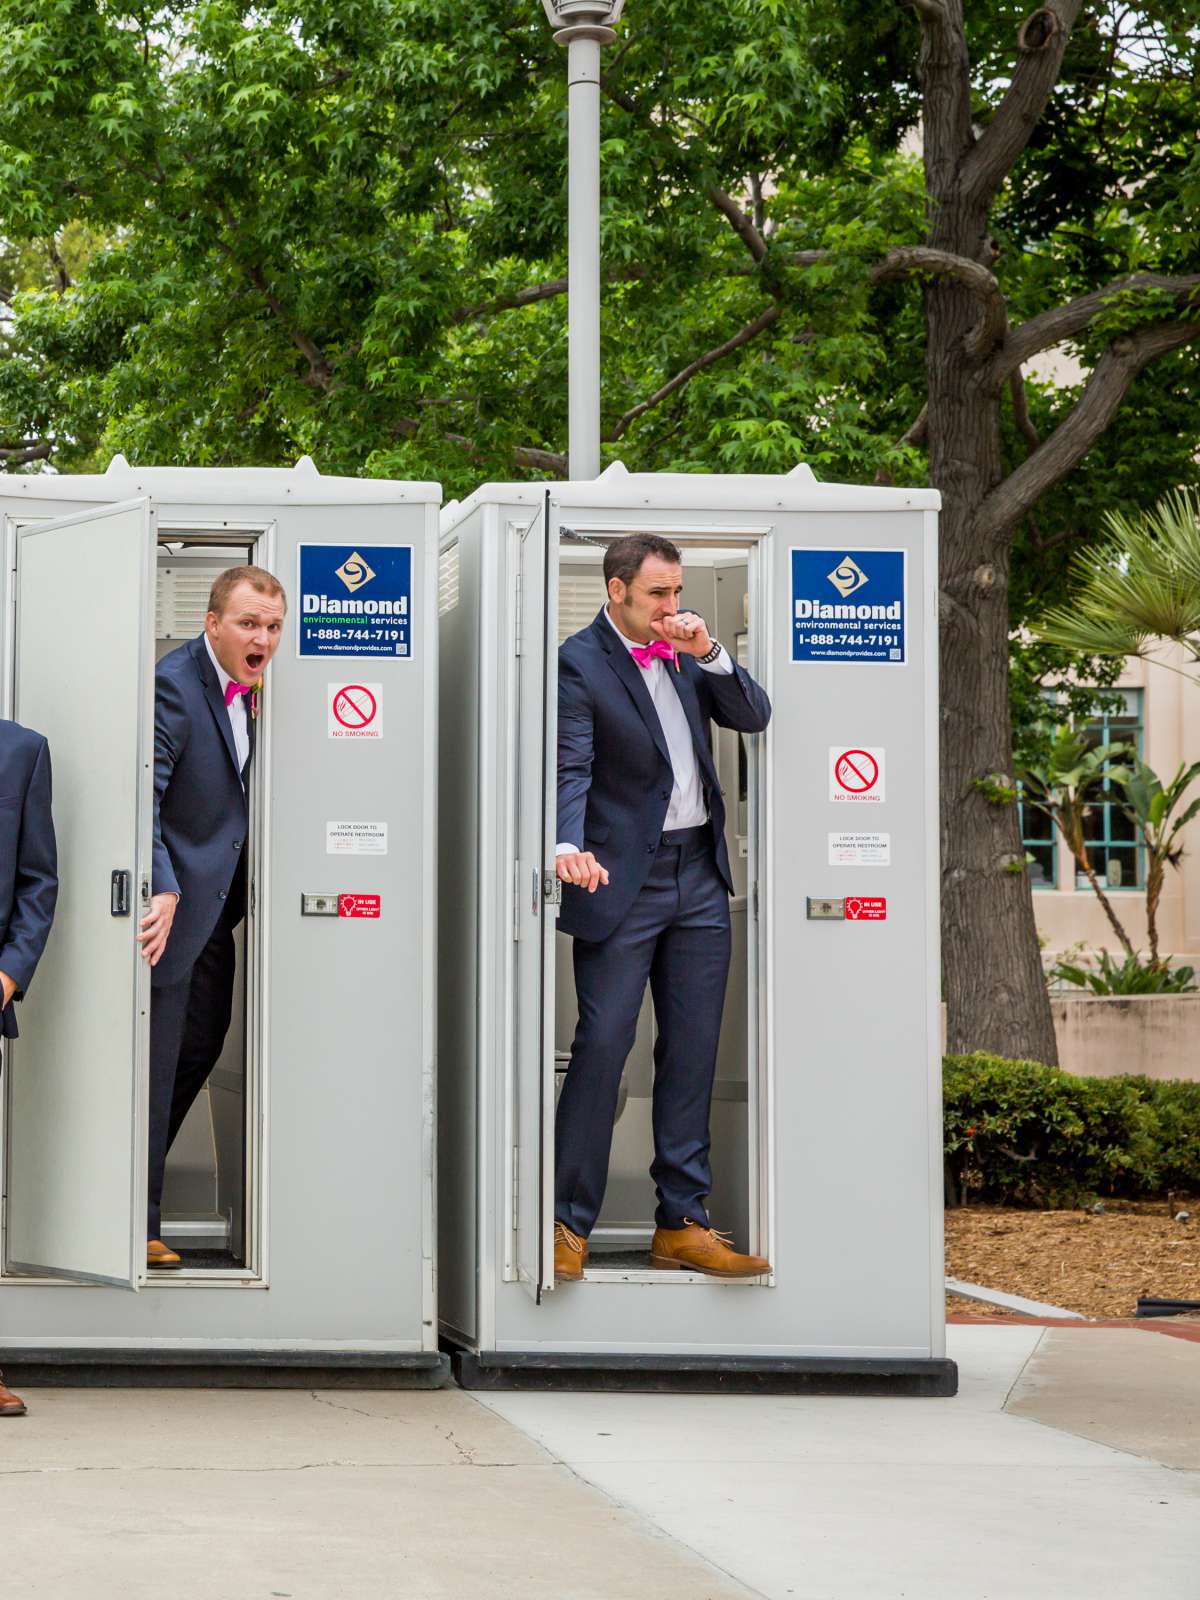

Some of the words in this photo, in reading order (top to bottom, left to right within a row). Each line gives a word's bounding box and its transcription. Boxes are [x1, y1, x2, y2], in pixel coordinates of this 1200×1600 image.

[303, 594, 408, 615] Diamond
[795, 600, 901, 620] Diamond
[304, 616, 368, 624] environmental
[371, 617, 407, 625] services
[796, 621, 860, 629] environmental
[864, 622, 901, 630] services
[307, 629, 404, 641] 1-888-744-7191
[800, 634, 898, 646] 1-888-744-7191
[318, 644, 392, 652] www.diamondprovides.com
[846, 794, 880, 802] SMOKING
